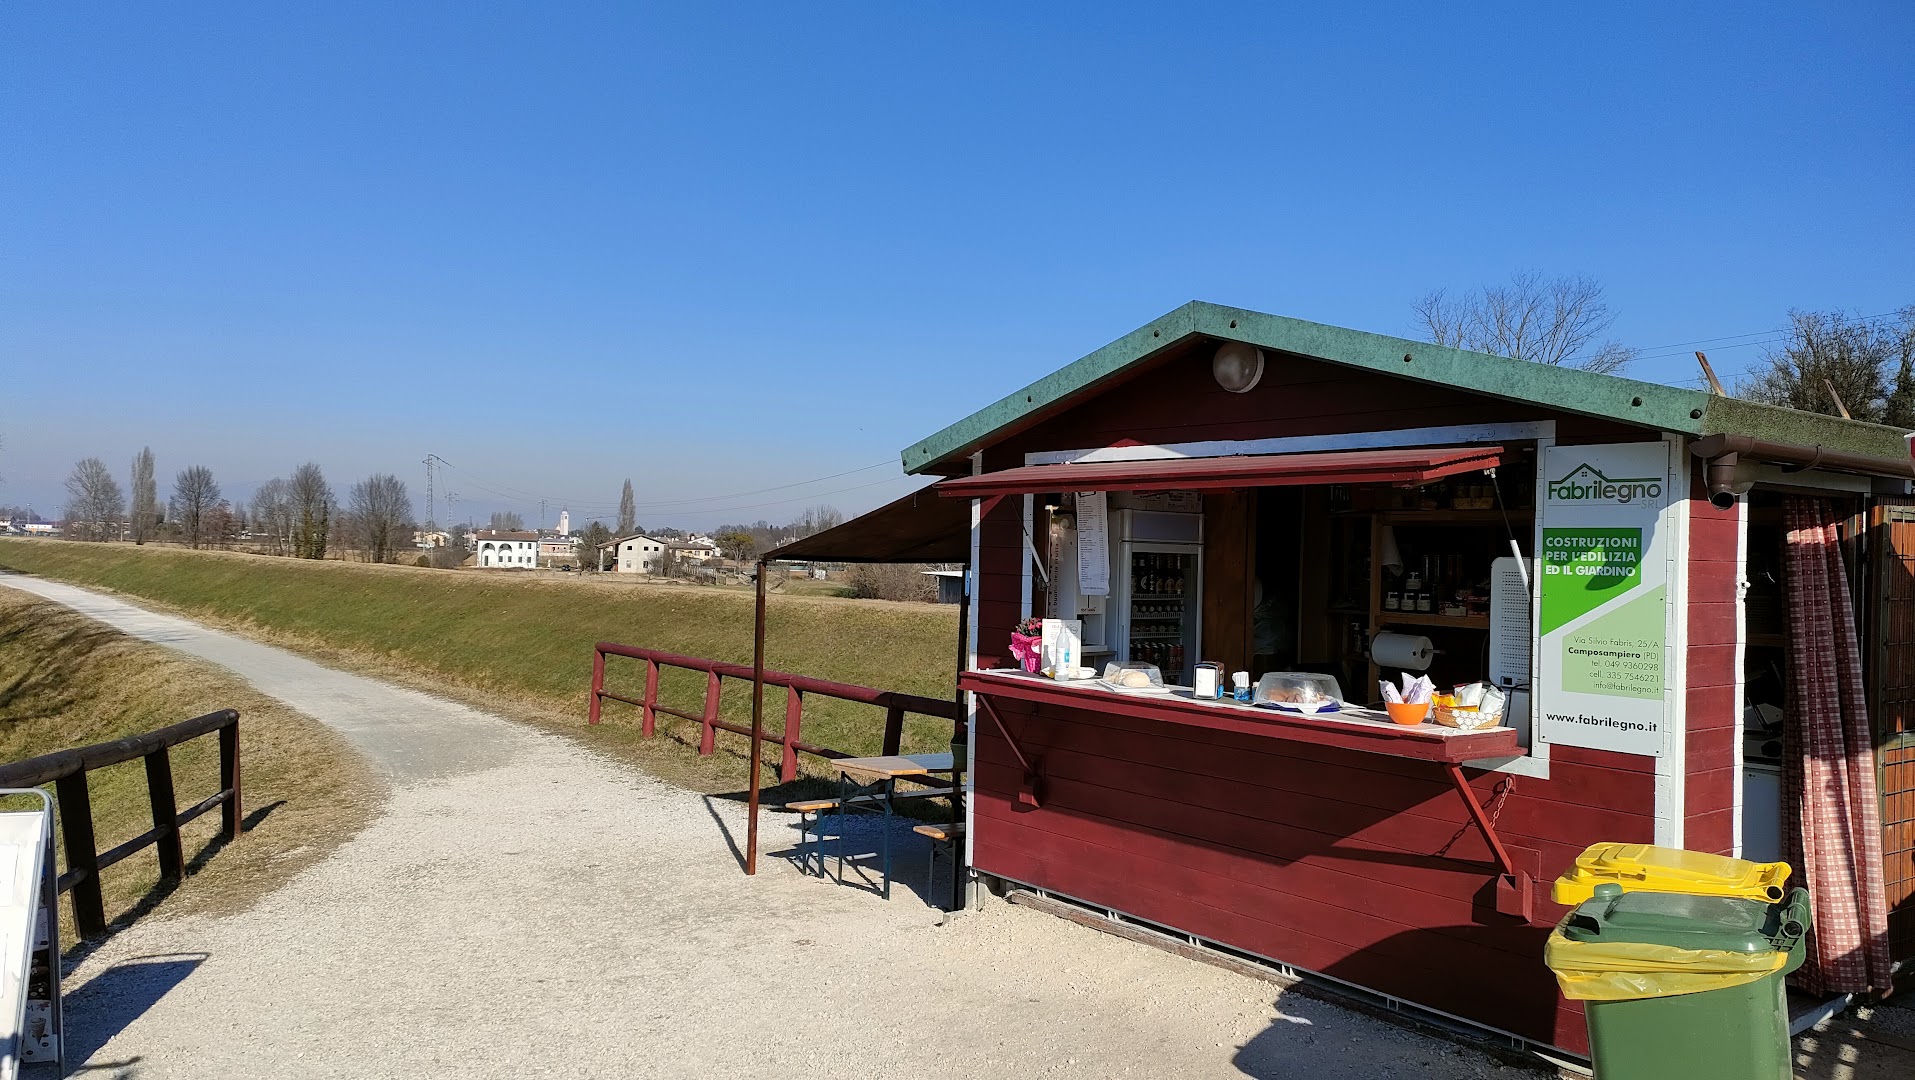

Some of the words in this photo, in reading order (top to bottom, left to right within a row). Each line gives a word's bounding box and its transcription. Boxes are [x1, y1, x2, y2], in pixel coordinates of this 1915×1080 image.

[1548, 480, 1661, 503] Fabrilegno
[1641, 500, 1660, 509] SRL
[1545, 537, 1637, 548] COSTRUZIONI
[1545, 551, 1568, 561] PER
[1572, 551, 1636, 562] L'EDILIZIA
[1545, 564, 1560, 575] ED
[1563, 565, 1573, 575] IL
[1575, 565, 1636, 577] GIARDINO
[1574, 636, 1586, 644] Via
[1588, 636, 1608, 646] Silvio
[1610, 638, 1635, 648] Fabris,
[1637, 639, 1659, 649] 25/A
[1568, 646, 1641, 659] Camposampiero
[1643, 651, 1659, 661] (PD)
[1604, 660, 1620, 668] 049
[1622, 661, 1659, 671] 9360298
[1589, 670, 1604, 678] cell.
[1606, 671, 1622, 679] 335
[1624, 672, 1659, 682] 7546221
[1593, 681, 1659, 694] info@fabrilegno.it
[1546, 712, 1657, 732] www.fabrilegno.it
